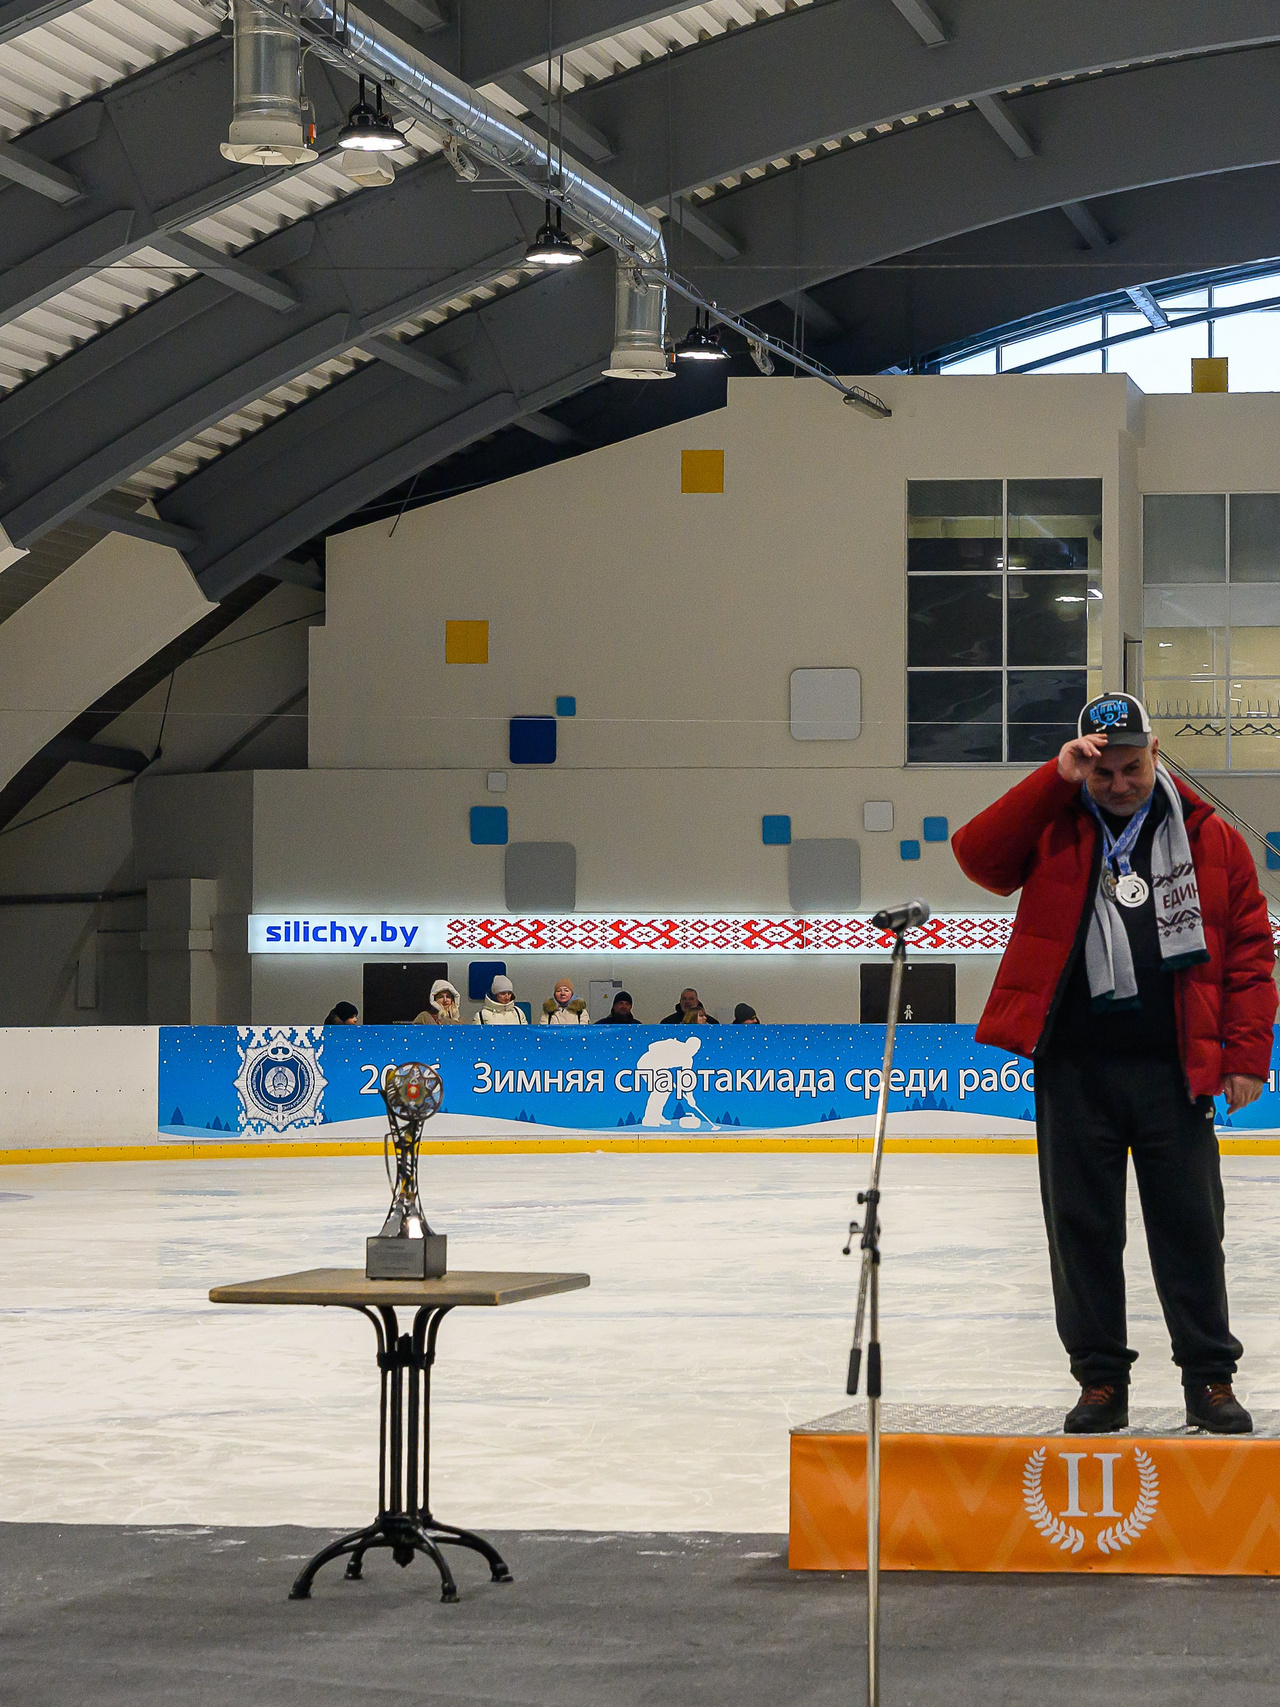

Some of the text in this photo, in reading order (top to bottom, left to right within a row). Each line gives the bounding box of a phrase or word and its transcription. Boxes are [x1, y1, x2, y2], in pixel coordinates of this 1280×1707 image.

[266, 921, 419, 947] silichy.by
[472, 1061, 605, 1094] Зимняя
[614, 1068, 835, 1100] спартакиада
[845, 1068, 948, 1100] среди
[1058, 1452, 1123, 1518] II
